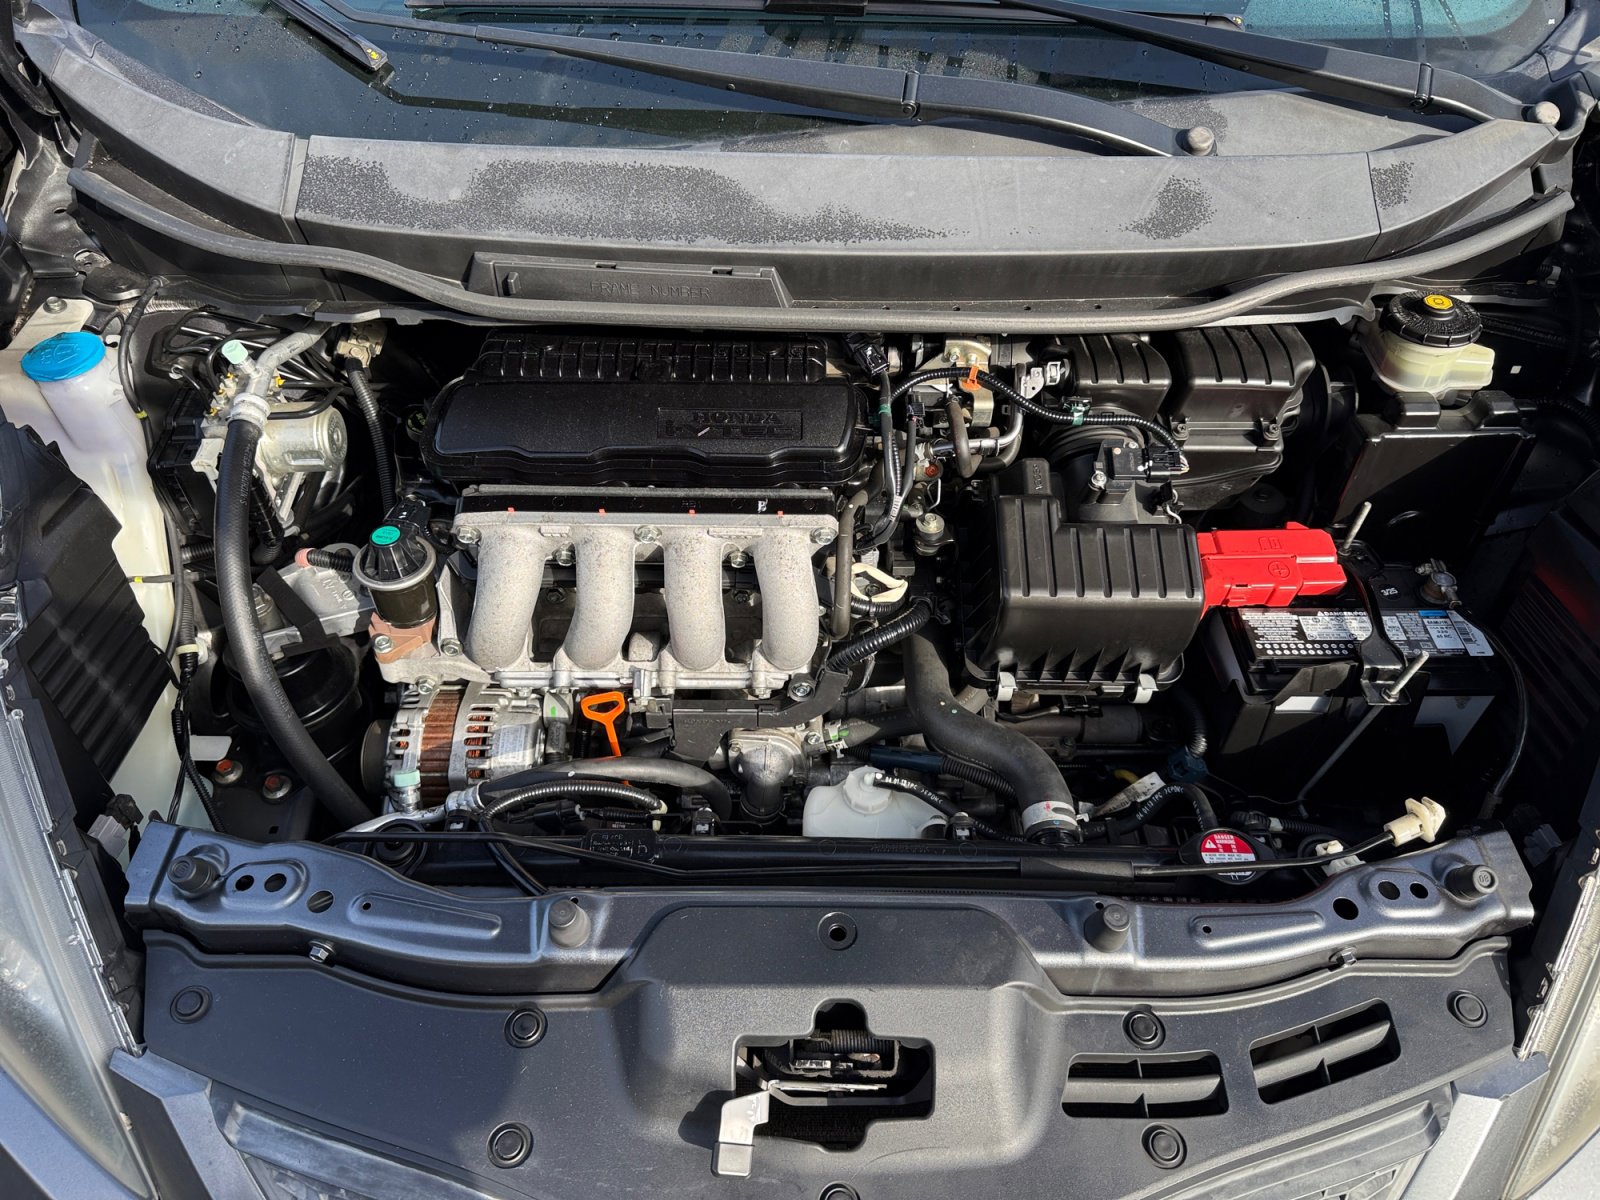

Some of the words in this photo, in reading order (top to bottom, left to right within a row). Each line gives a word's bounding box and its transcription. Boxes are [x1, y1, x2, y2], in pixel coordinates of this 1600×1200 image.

[590, 281, 639, 295] FRAME
[650, 284, 712, 298] NUMBER
[693, 410, 784, 424] HONDA
